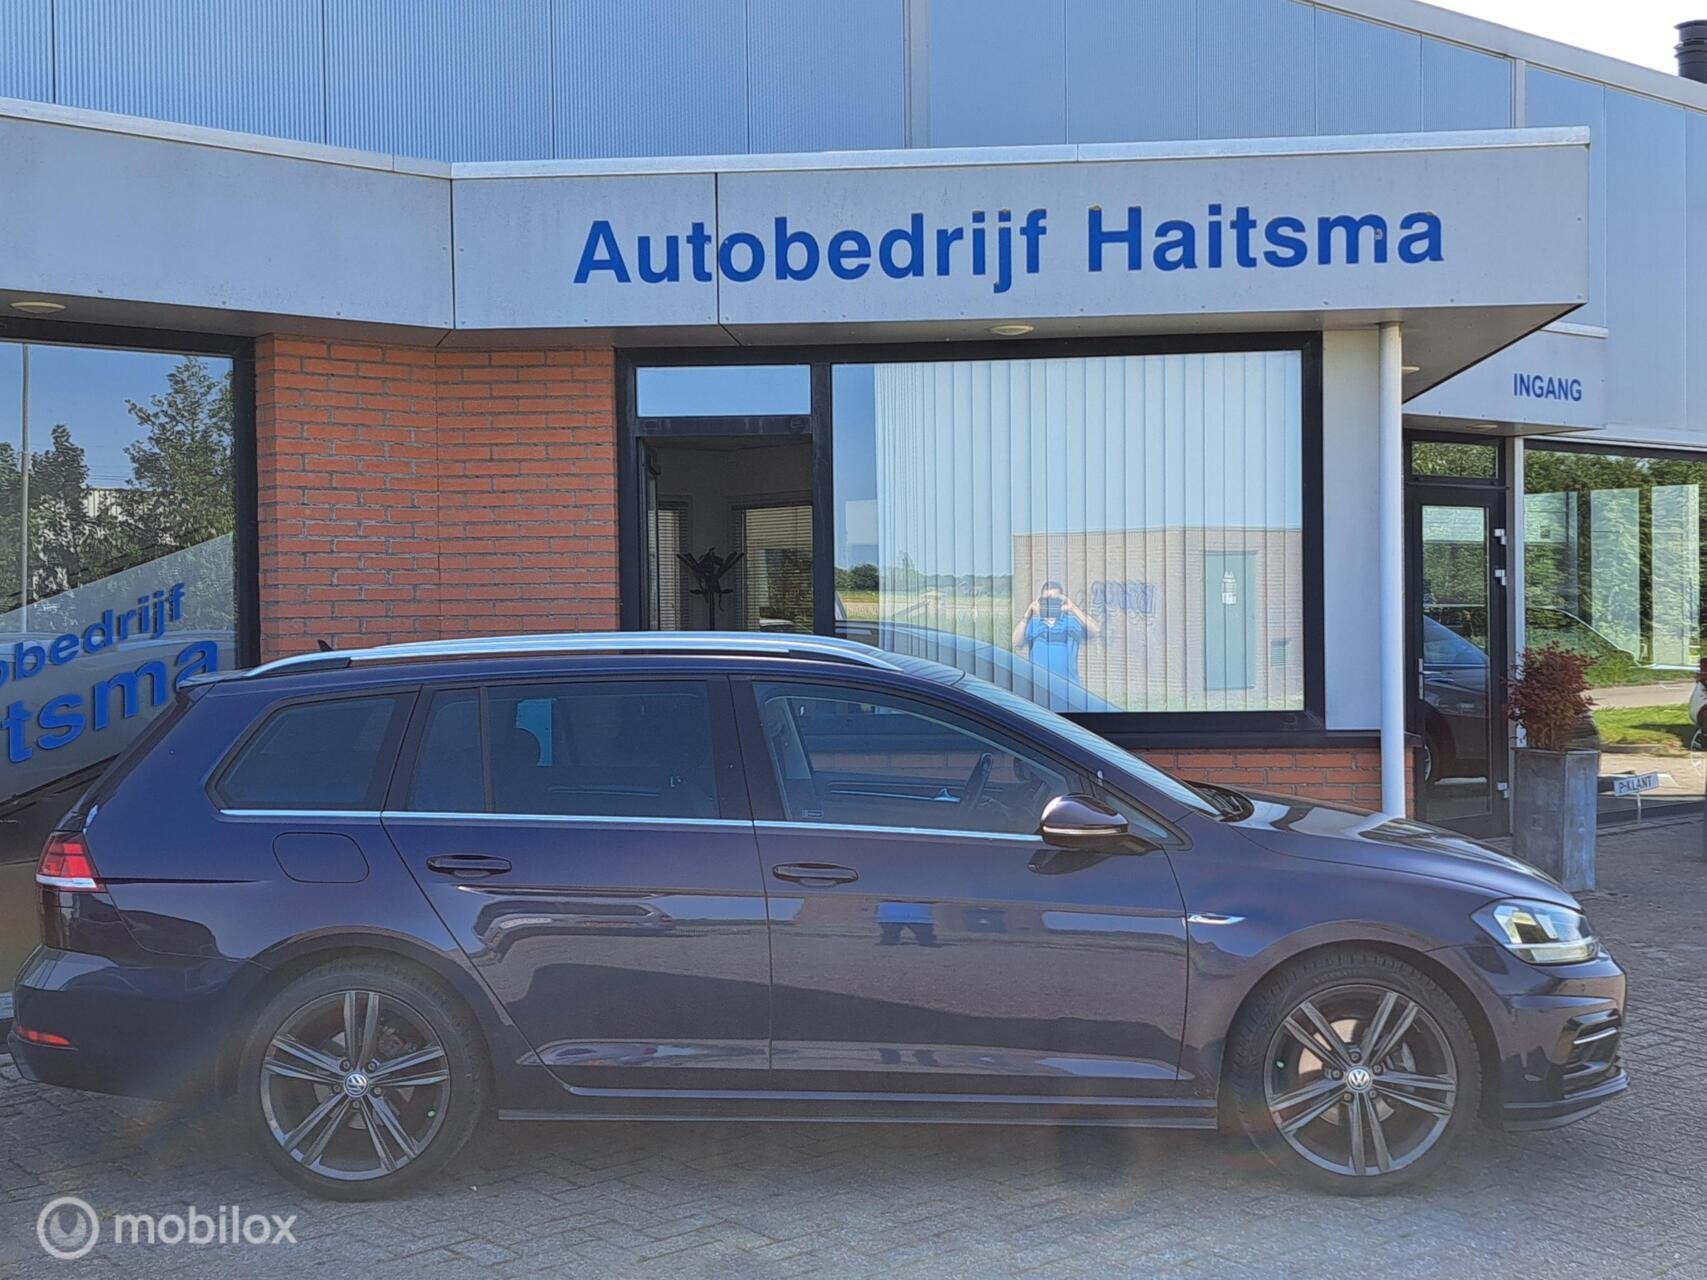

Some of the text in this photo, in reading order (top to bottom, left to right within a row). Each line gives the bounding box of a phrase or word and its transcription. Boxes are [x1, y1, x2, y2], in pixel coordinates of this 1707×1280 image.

[573, 203, 1445, 293] Autobedrijf Haitsma
[1513, 373, 1582, 402] INGANG
[0, 582, 186, 689] bedrijf
